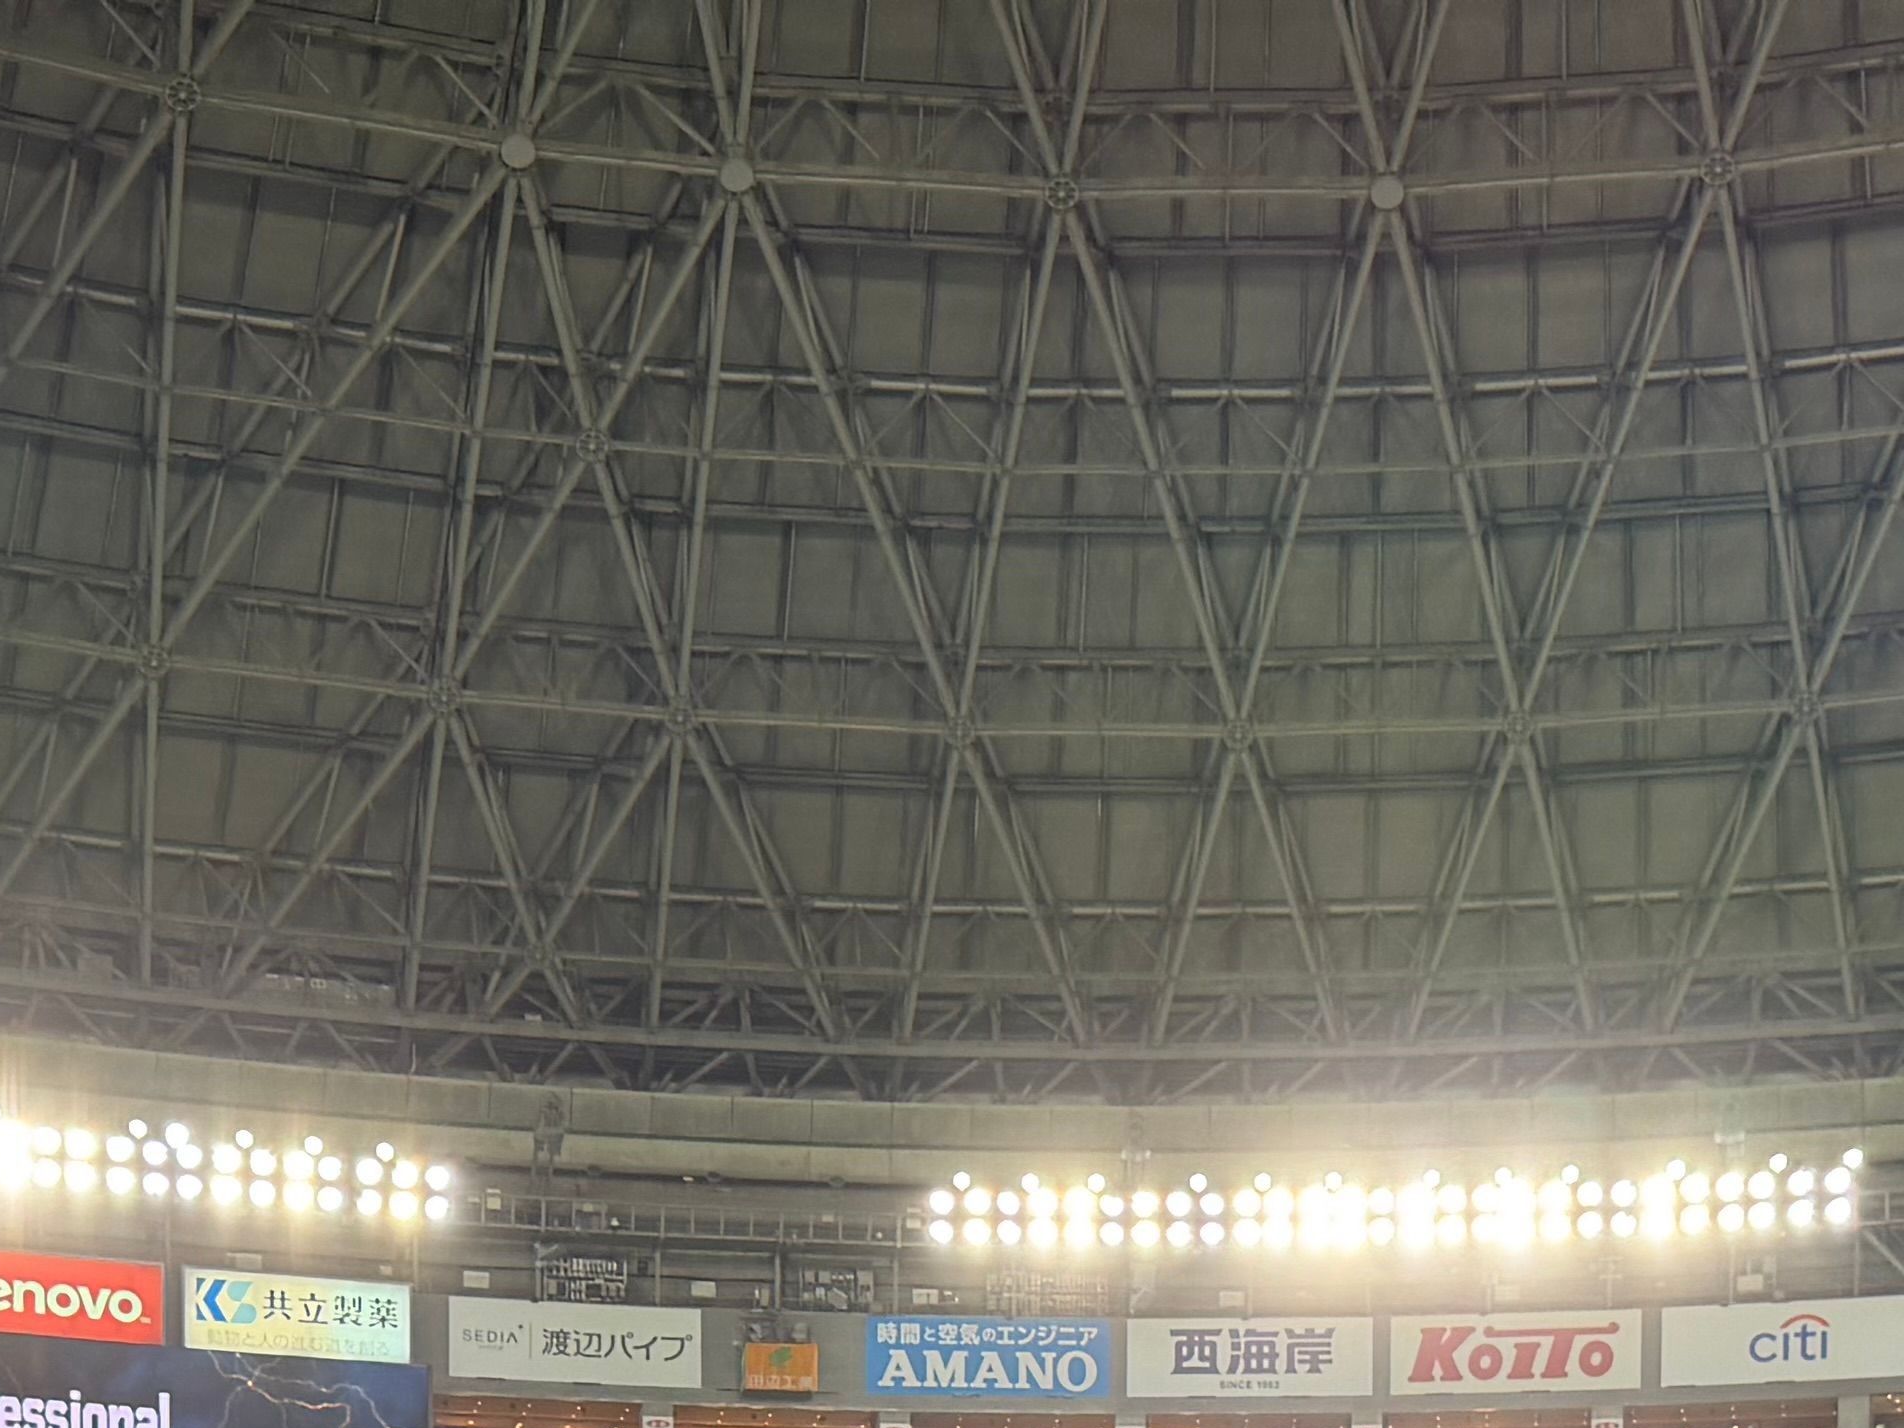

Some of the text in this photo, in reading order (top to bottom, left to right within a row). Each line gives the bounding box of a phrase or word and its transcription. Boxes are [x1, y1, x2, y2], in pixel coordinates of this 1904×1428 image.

[262, 1288, 399, 1330] 共立製薬
[541, 1327, 693, 1362] 渡辺パイプ
[876, 1320, 1098, 1347] 時間と空気のエンジニア
[1169, 1326, 1336, 1376] 西海岸
[1749, 1314, 1830, 1364] citi
[877, 1349, 1098, 1394] AMANO
